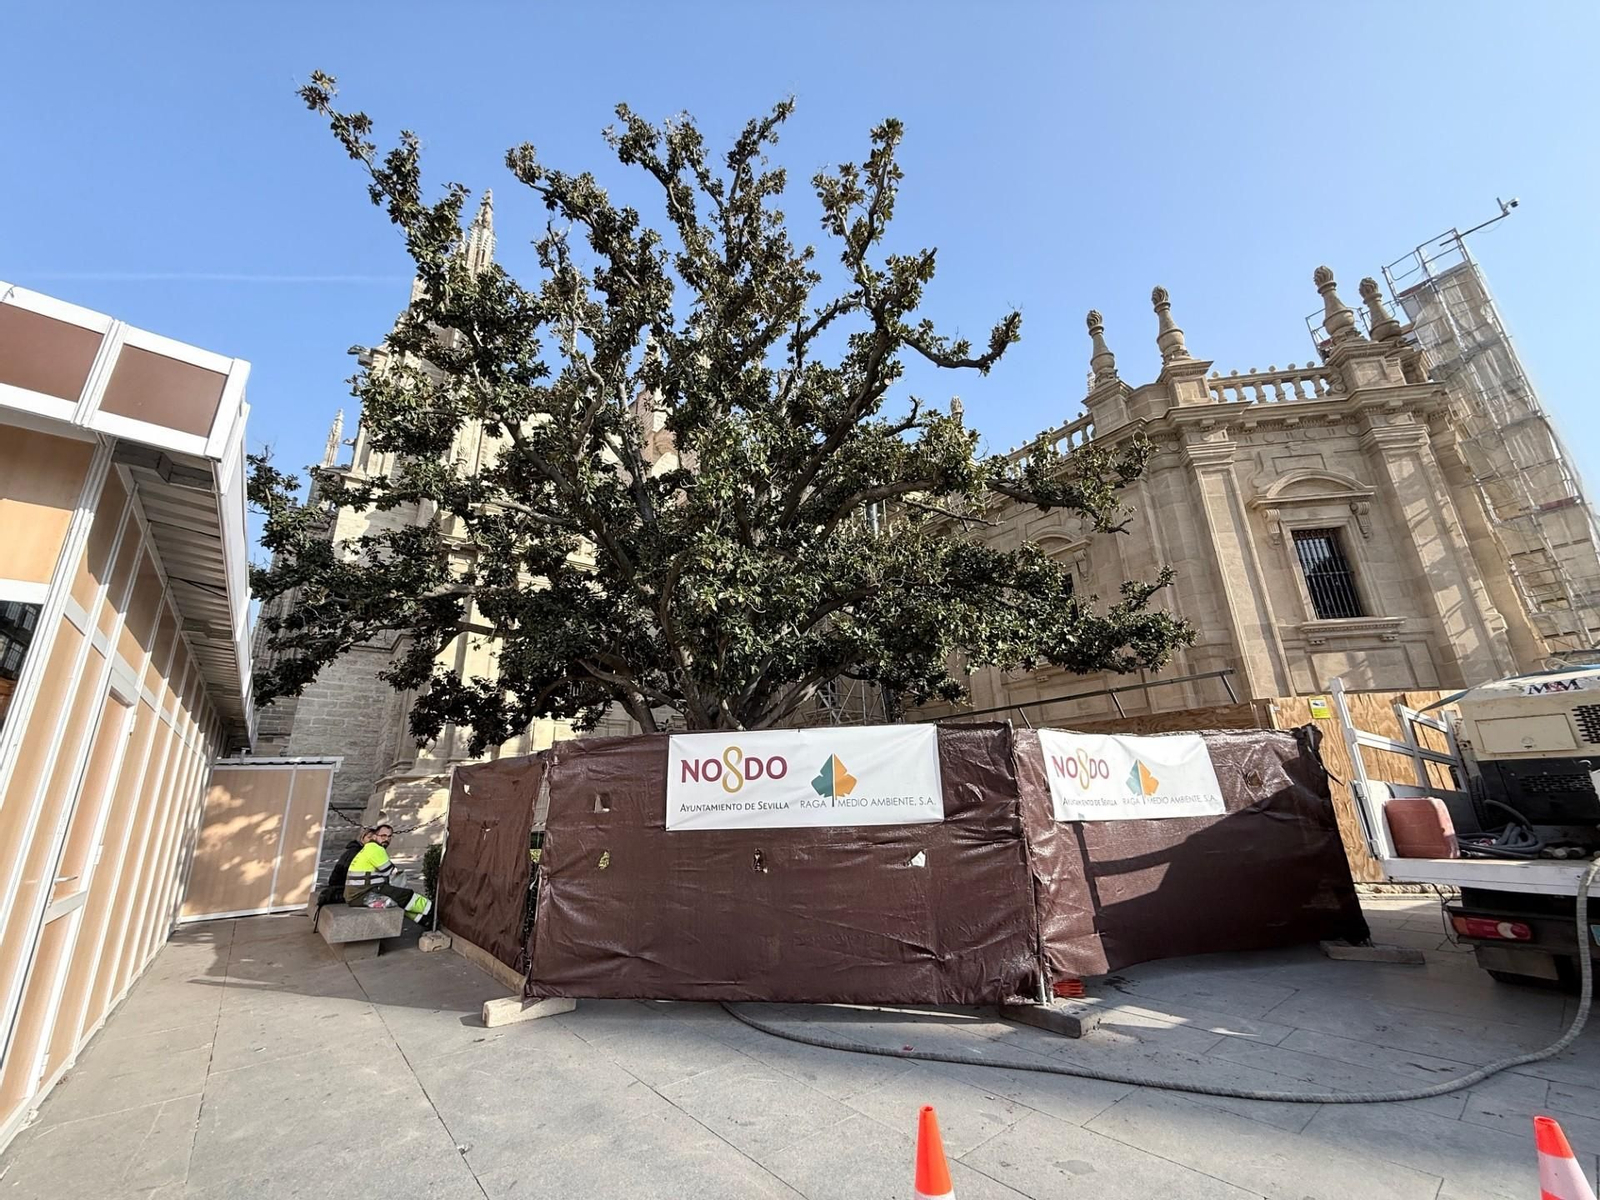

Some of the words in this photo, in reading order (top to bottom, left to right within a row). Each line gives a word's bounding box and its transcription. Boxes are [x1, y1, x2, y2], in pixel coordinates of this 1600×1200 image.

[800, 799, 828, 809] RAGA
[837, 797, 869, 808] MEDIO
[870, 796, 917, 807] AMBIENTE,
[918, 796, 937, 806] S.A.
[1147, 796, 1169, 805] MEDIO
[744, 802, 756, 811] DE
